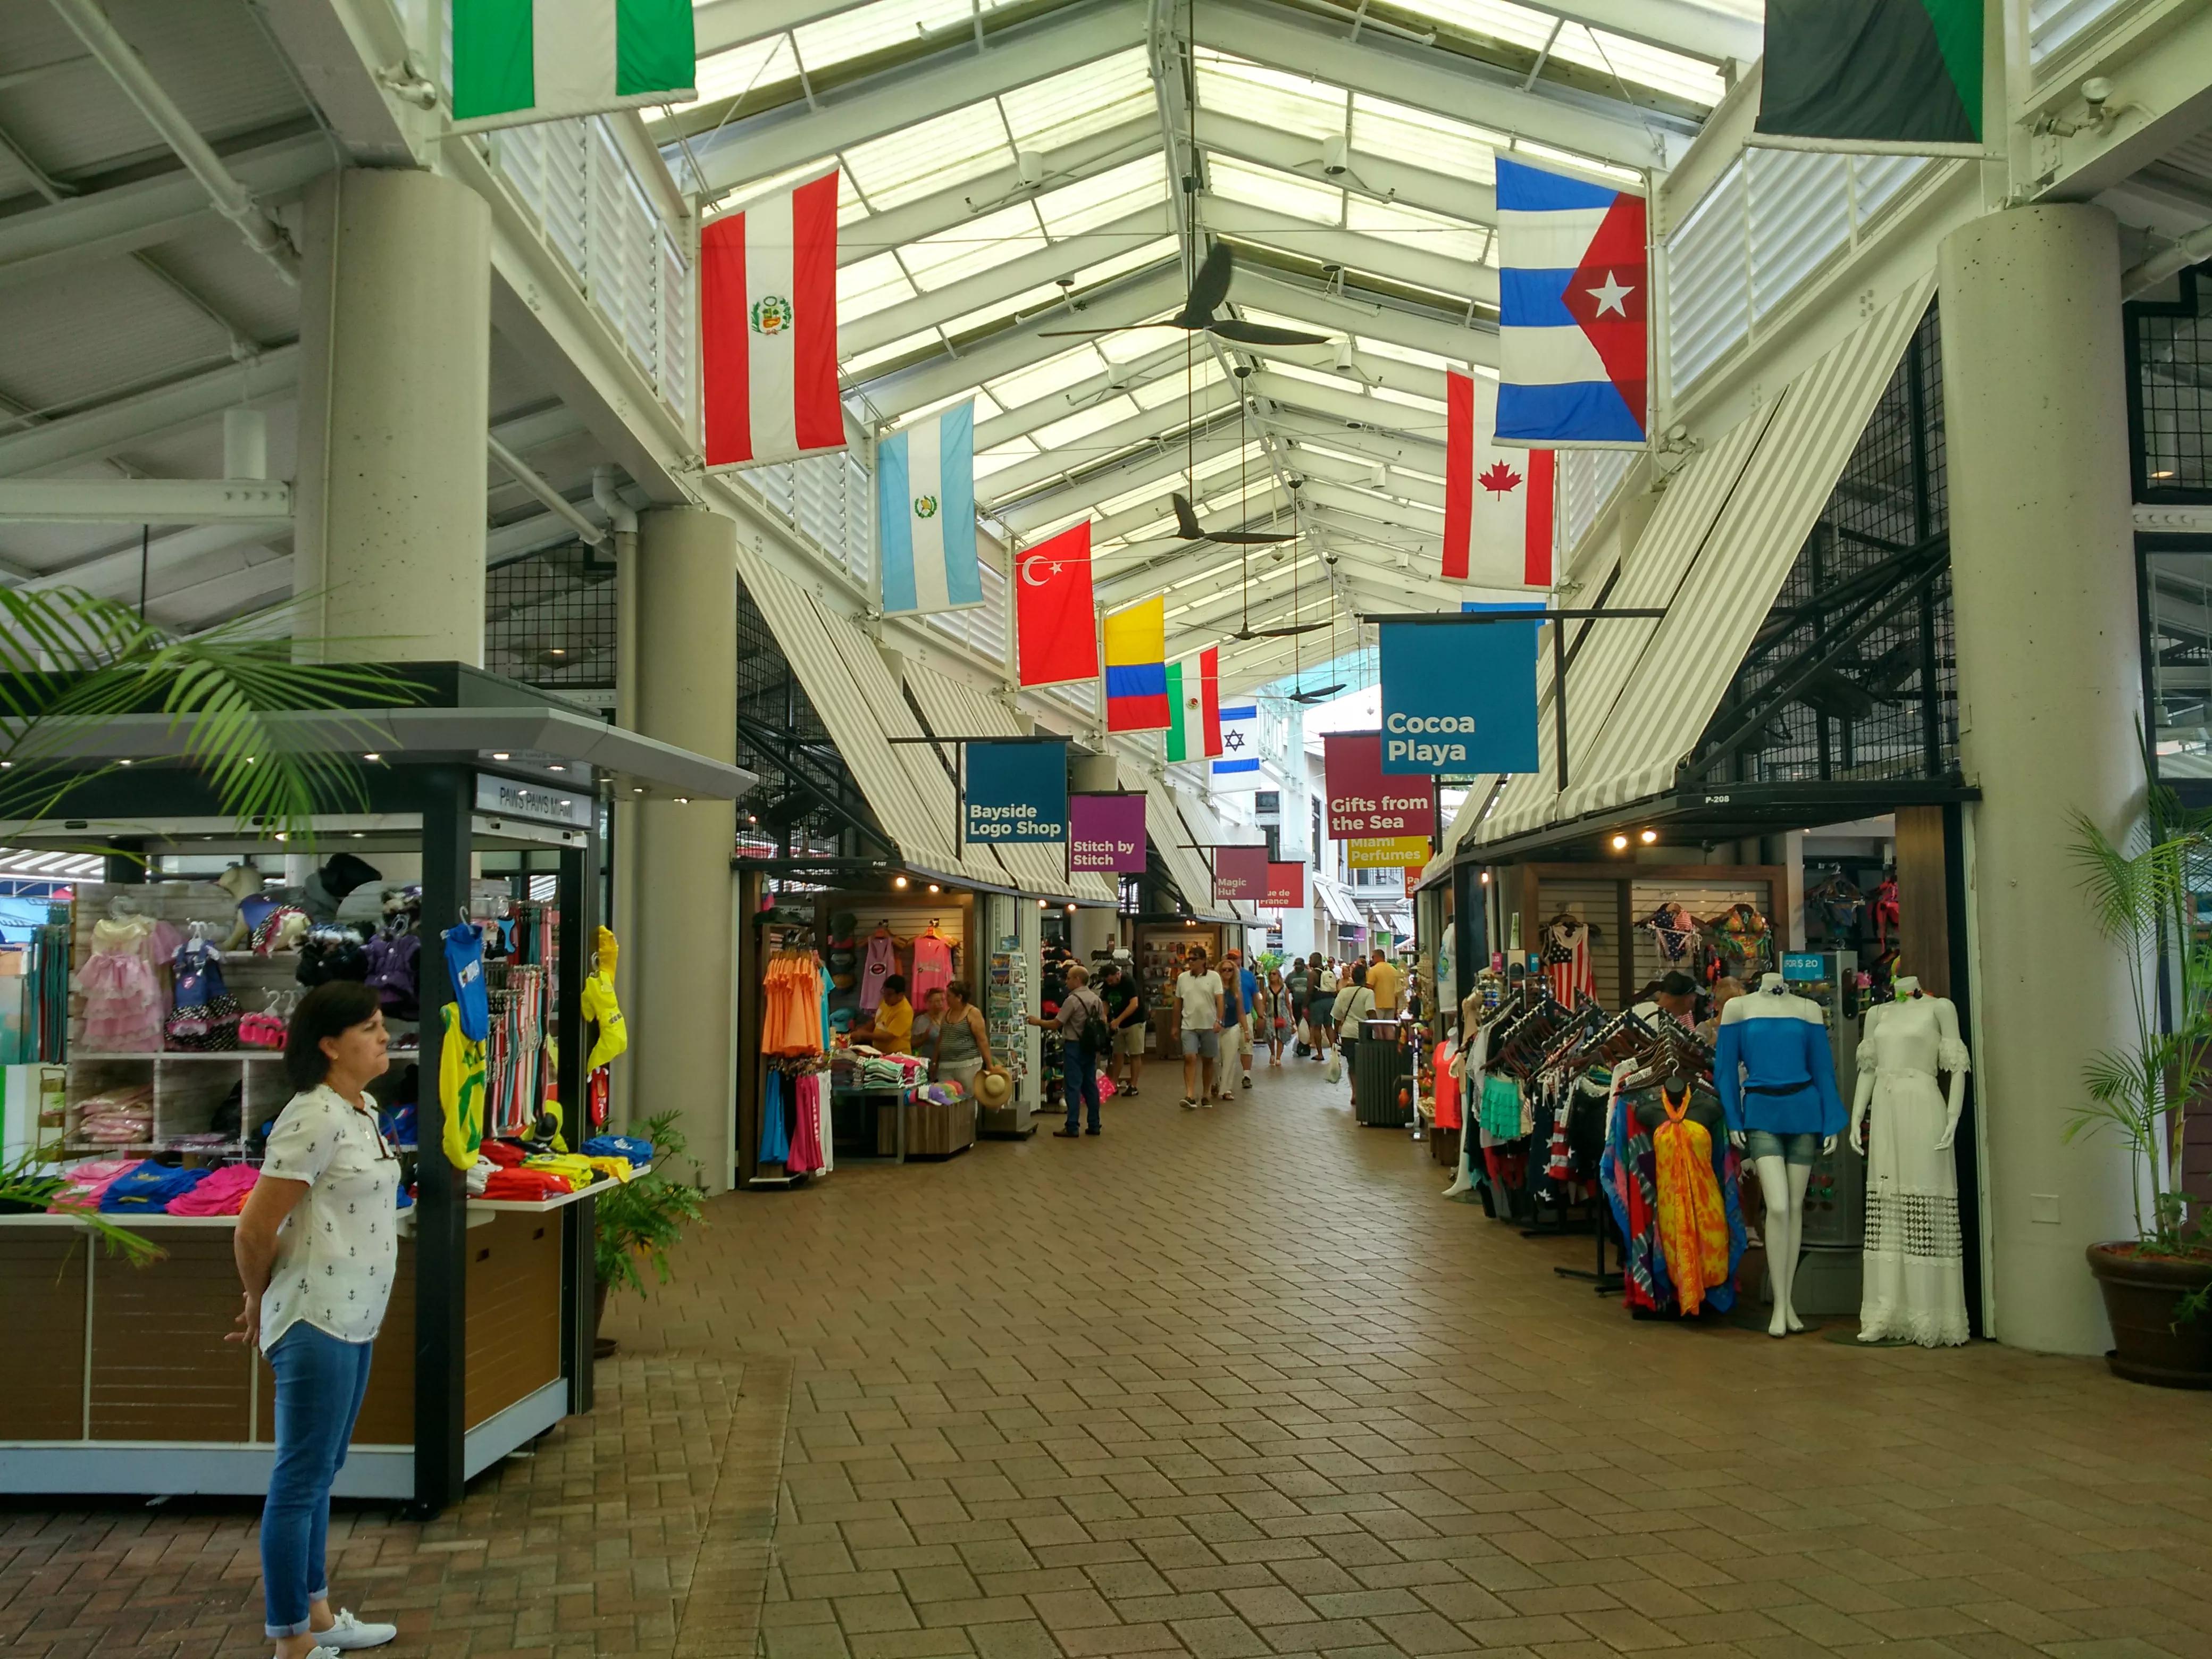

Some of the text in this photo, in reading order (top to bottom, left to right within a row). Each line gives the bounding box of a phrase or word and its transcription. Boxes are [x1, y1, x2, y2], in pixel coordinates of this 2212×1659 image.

[1387, 713, 1475, 733] Cocoa
[1388, 740, 1467, 766] Playa
[500, 786, 524, 809] PAWS
[526, 793, 549, 814] PAWS
[1331, 796, 1428, 813] Gifts from
[970, 804, 1037, 821] Bayside
[970, 821, 1061, 837] Logo Shop
[1331, 815, 1404, 831] the Sea
[1073, 841, 1135, 854] Stitch by
[1351, 837, 1395, 848] Miami
[1073, 854, 1114, 866] Stitch
[1351, 850, 1421, 861] Perfumes
[1218, 878, 1247, 887] Magic
[1805, 959, 1819, 968] 20
